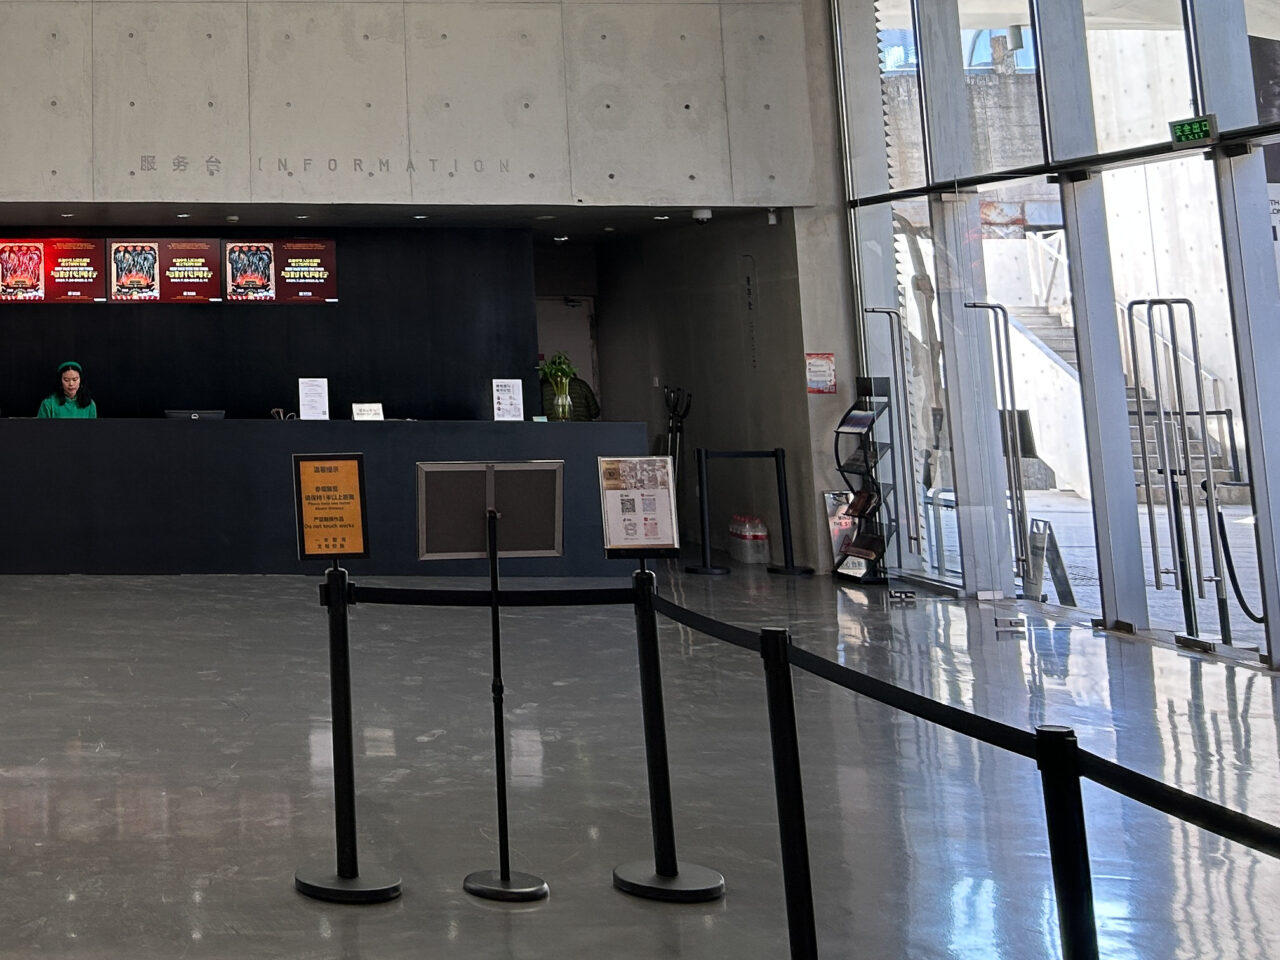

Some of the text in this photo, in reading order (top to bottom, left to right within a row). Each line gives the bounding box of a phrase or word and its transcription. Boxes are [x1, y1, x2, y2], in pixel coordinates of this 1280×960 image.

[1175, 122, 1209, 136] 安全出口
[1181, 133, 1204, 142] EXIT
[140, 155, 511, 175] 服务台 INFORMATION
